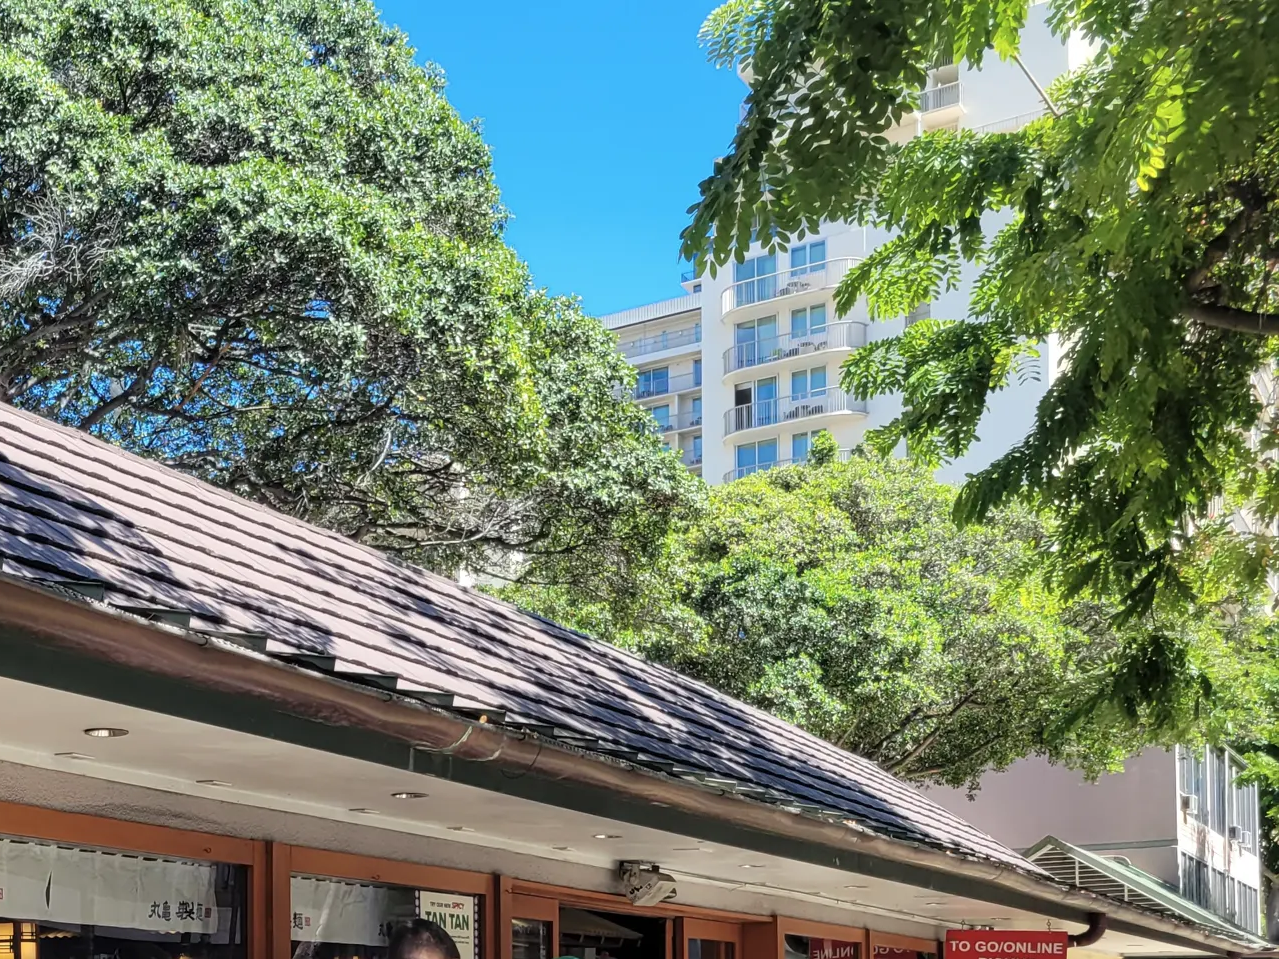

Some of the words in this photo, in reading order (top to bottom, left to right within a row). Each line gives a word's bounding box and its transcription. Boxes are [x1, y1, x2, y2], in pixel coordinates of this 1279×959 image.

[451, 901, 465, 910] SPICY
[425, 910, 447, 930] TAN
[449, 913, 470, 931] TAN
[949, 940, 971, 952] TO
[974, 941, 1063, 954] GO/ONLINE
